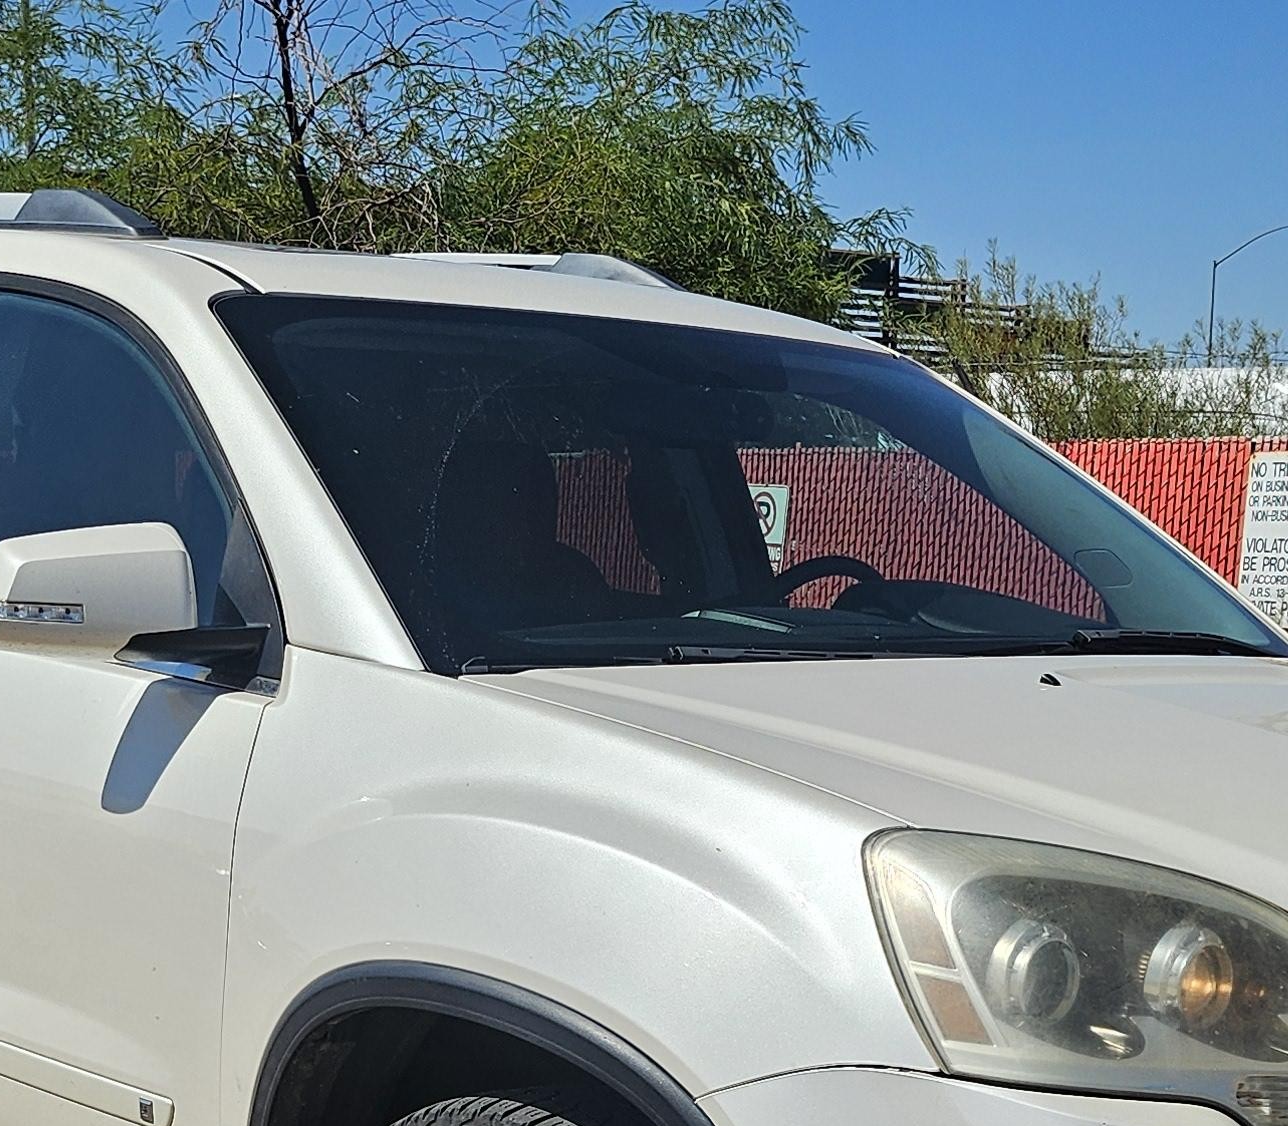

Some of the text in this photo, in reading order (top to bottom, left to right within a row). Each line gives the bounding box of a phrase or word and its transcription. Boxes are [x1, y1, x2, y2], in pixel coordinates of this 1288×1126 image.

[1251, 462, 1267, 477] NO
[1251, 481, 1263, 492] ON
[1249, 495, 1260, 507] OR
[1243, 556, 1258, 571] BE
[1241, 575, 1249, 584] IN
